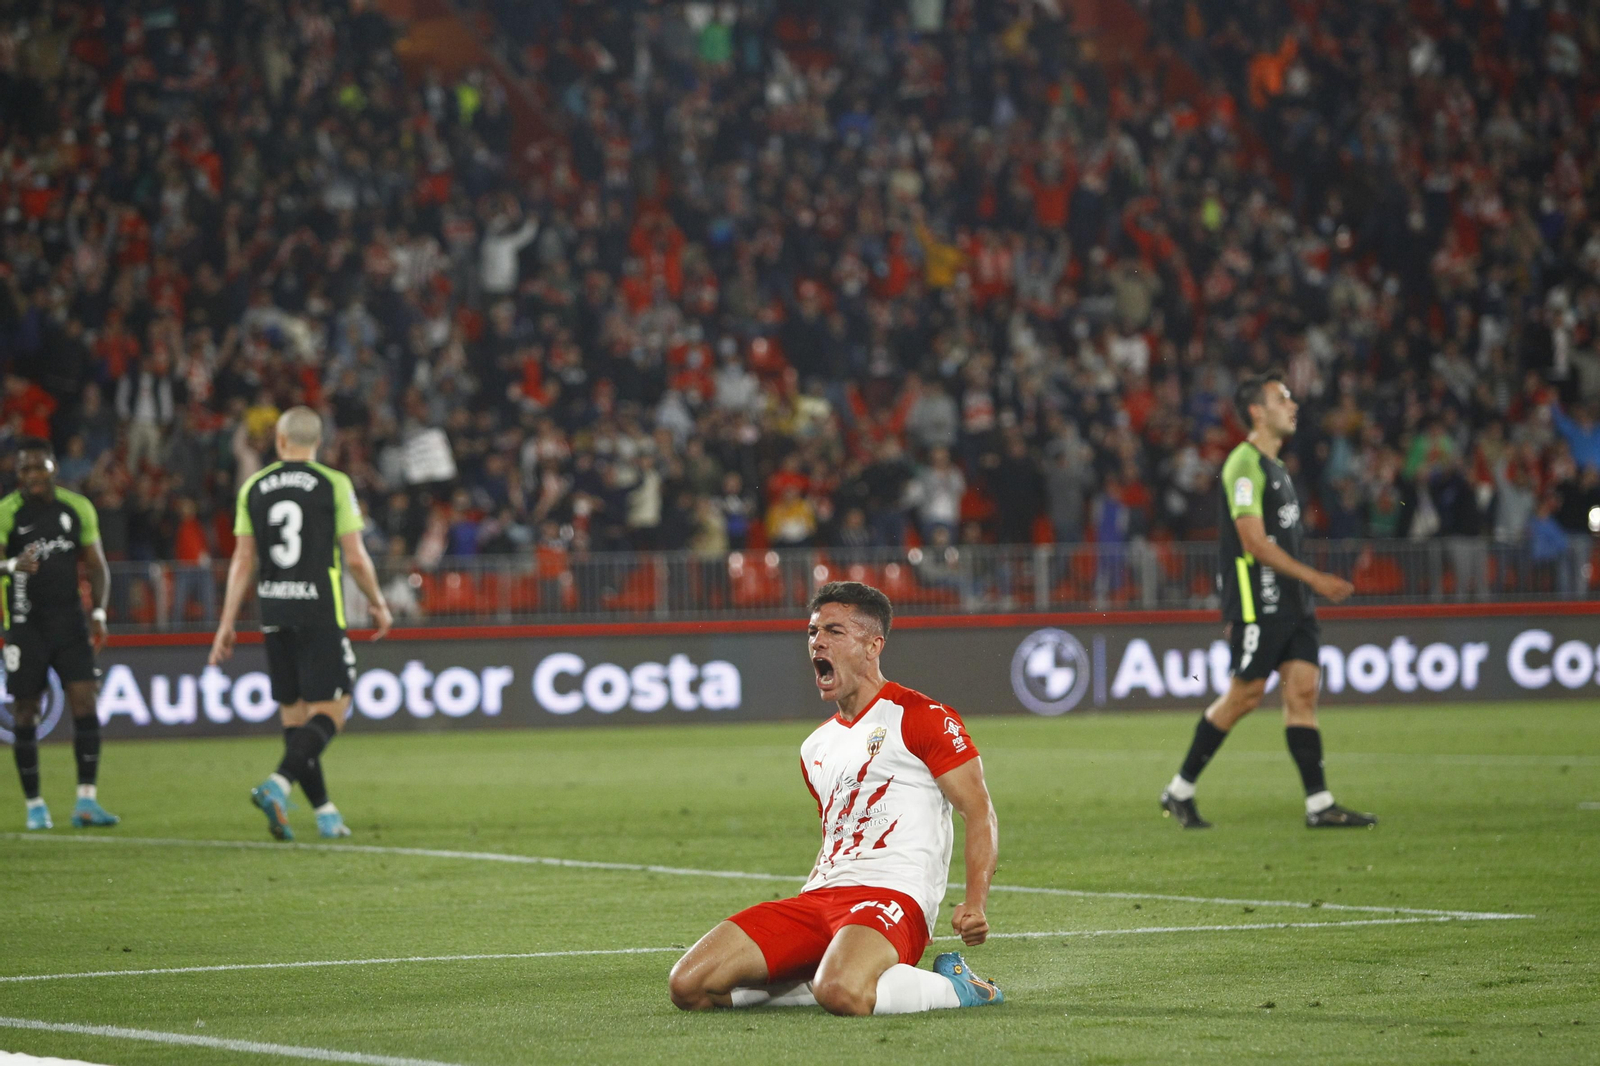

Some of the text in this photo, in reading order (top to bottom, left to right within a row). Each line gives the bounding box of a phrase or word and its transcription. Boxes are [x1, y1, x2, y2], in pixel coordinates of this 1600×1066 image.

[267, 499, 303, 570] 3
[97, 652, 741, 727] Autootor Costa
